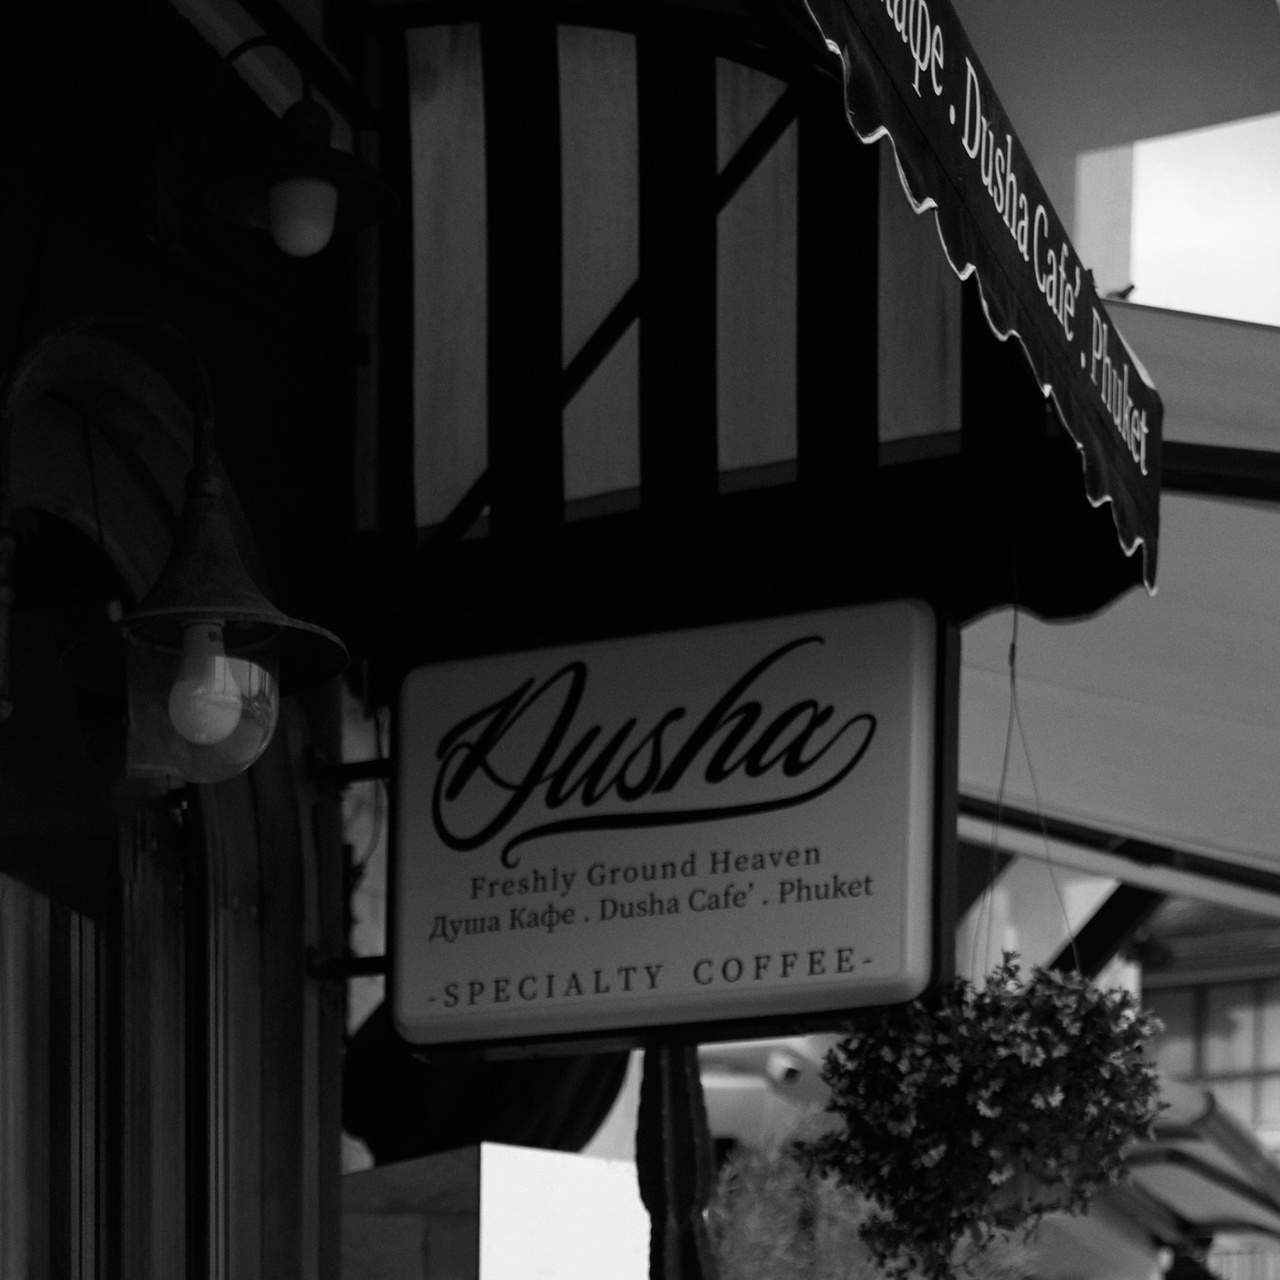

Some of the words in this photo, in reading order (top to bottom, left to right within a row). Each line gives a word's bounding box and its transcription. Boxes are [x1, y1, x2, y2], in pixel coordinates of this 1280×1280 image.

[962, 56, 1030, 262] Dusha
[1091, 306, 1149, 475] Phuket
[432, 635, 877, 868] Dusha
[428, 915, 501, 943] Душа
[509, 903, 576, 934] Кафе
[599, 893, 680, 921] Dusha
[778, 875, 875, 904] Phuket
[470, 867, 577, 899] Freshly
[587, 853, 697, 887] Ground
[710, 848, 821, 875] Heaven
